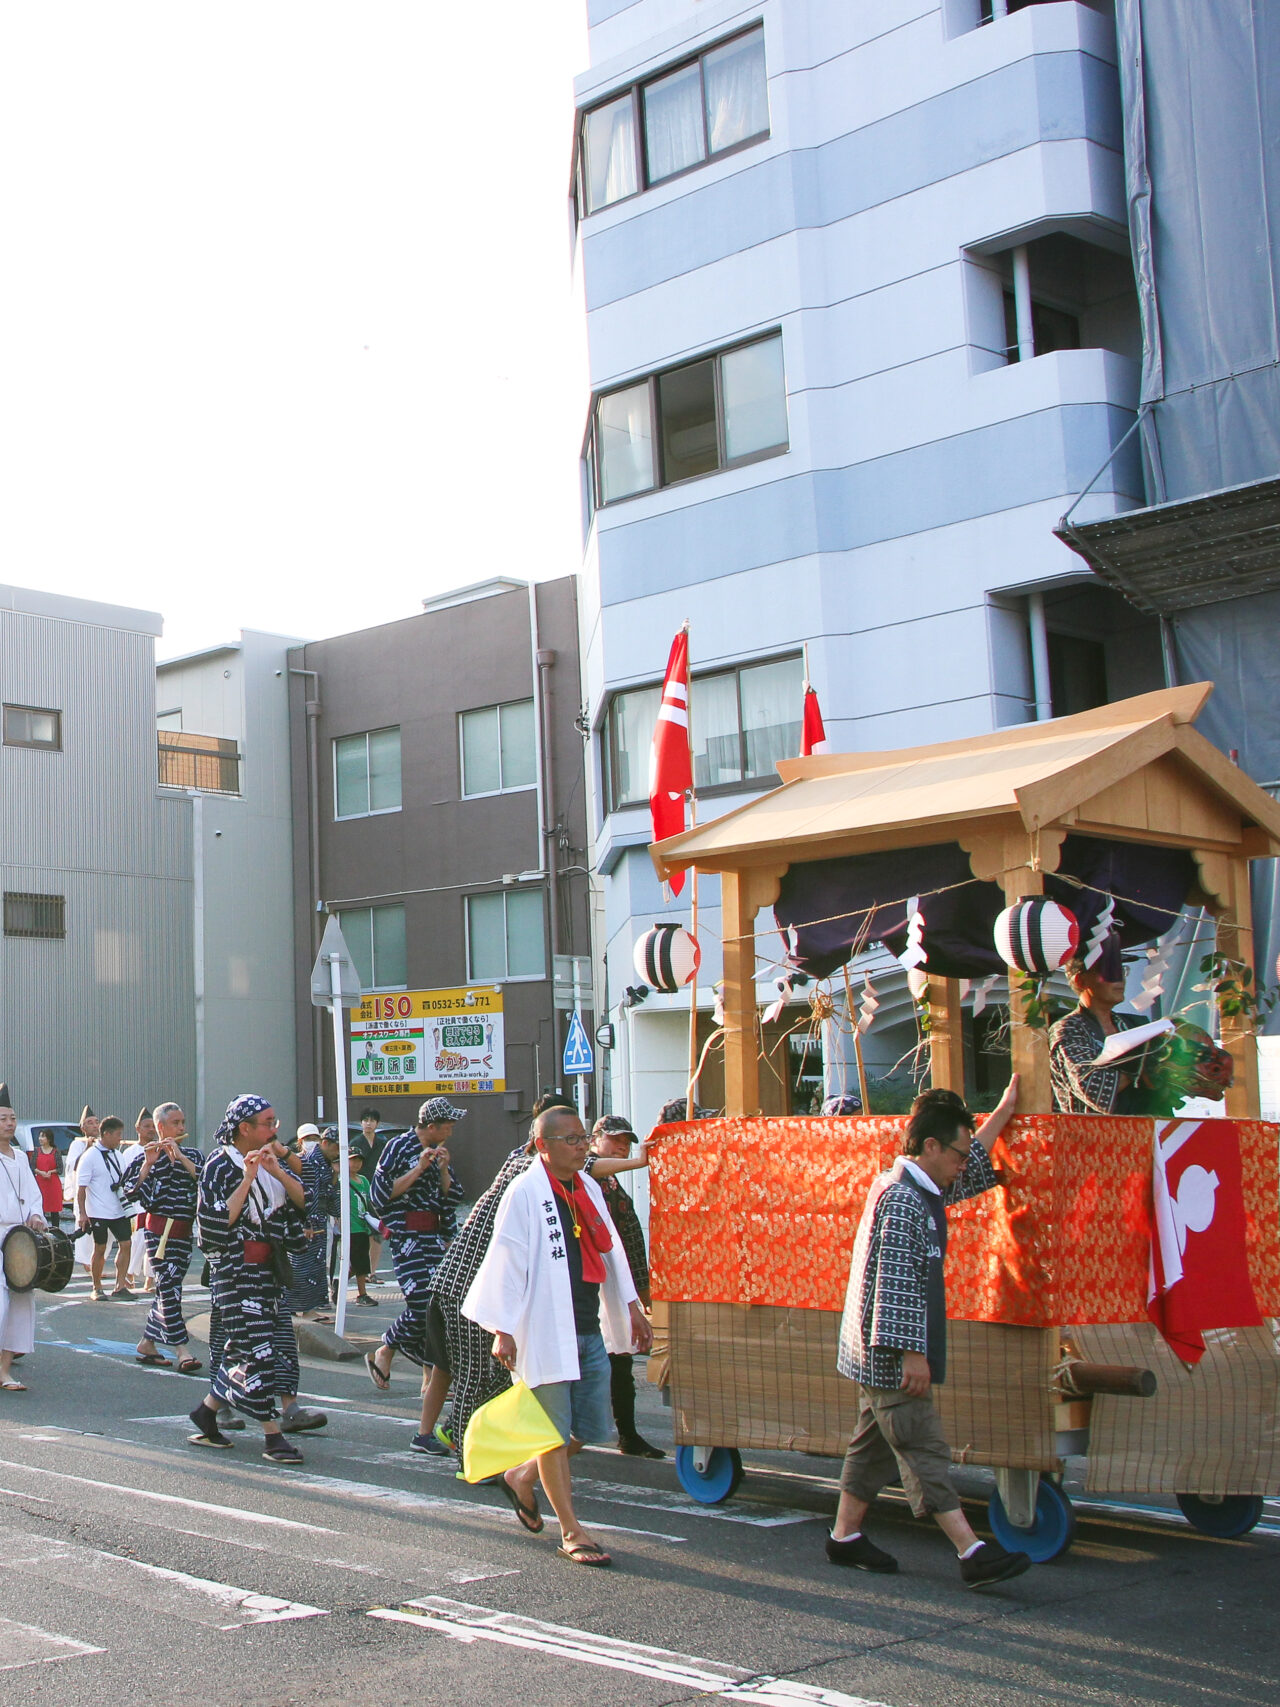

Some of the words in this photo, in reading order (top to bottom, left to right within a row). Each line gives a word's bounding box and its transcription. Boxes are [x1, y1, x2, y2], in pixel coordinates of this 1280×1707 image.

[360, 1001, 372, 1009] 株式
[375, 996, 412, 1019] ISO
[432, 997, 490, 1009] 0532-52771
[358, 1058, 415, 1074] 人財派遣
[434, 1054, 493, 1072] みかわーく
[438, 1071, 489, 1079] www.mika-work.jp
[364, 1084, 410, 1094] 昭和61年創業
[542, 1199, 566, 1261] 吉田神社
